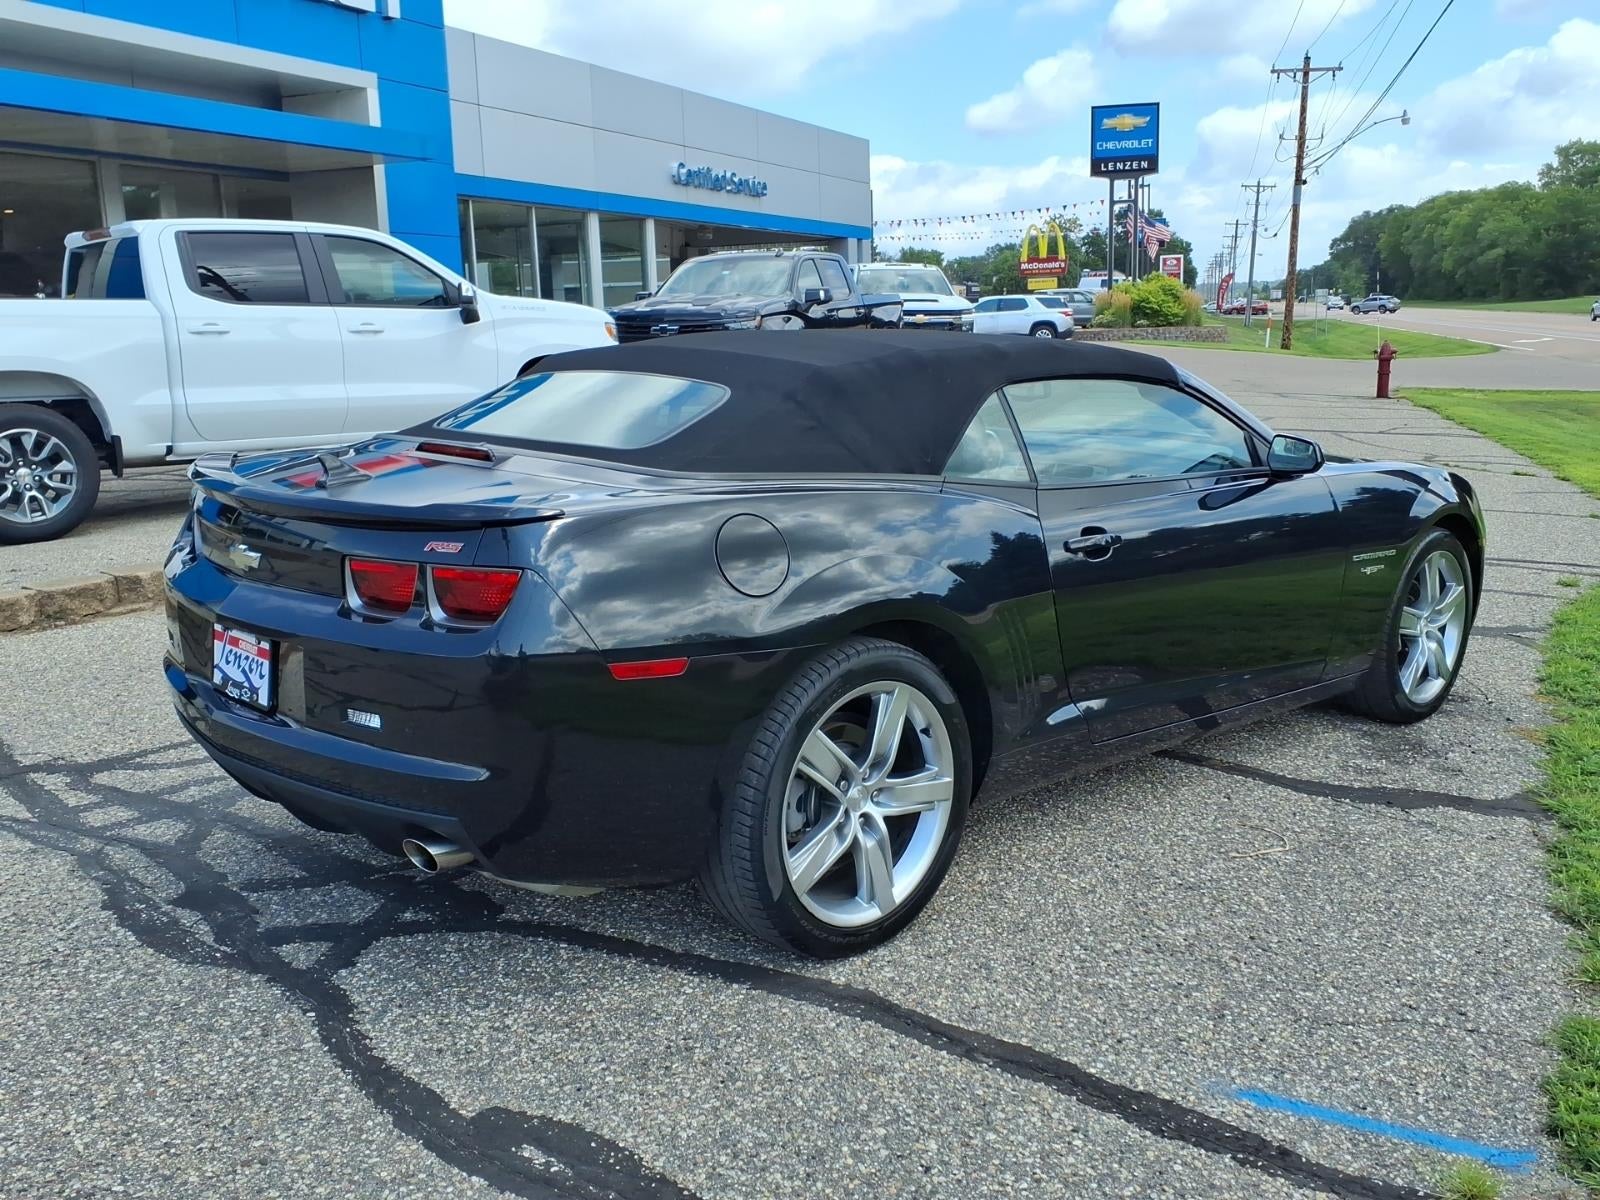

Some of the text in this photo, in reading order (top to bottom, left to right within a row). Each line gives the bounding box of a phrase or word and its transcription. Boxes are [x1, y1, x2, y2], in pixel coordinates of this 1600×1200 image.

[1096, 139, 1153, 150] CHEVROLET
[1101, 160, 1148, 171] LENZEN
[672, 162, 768, 198] Certified Service
[1020, 261, 1065, 270] McDonald's
[423, 541, 464, 553] RS
[214, 630, 267, 686] Lenzen
